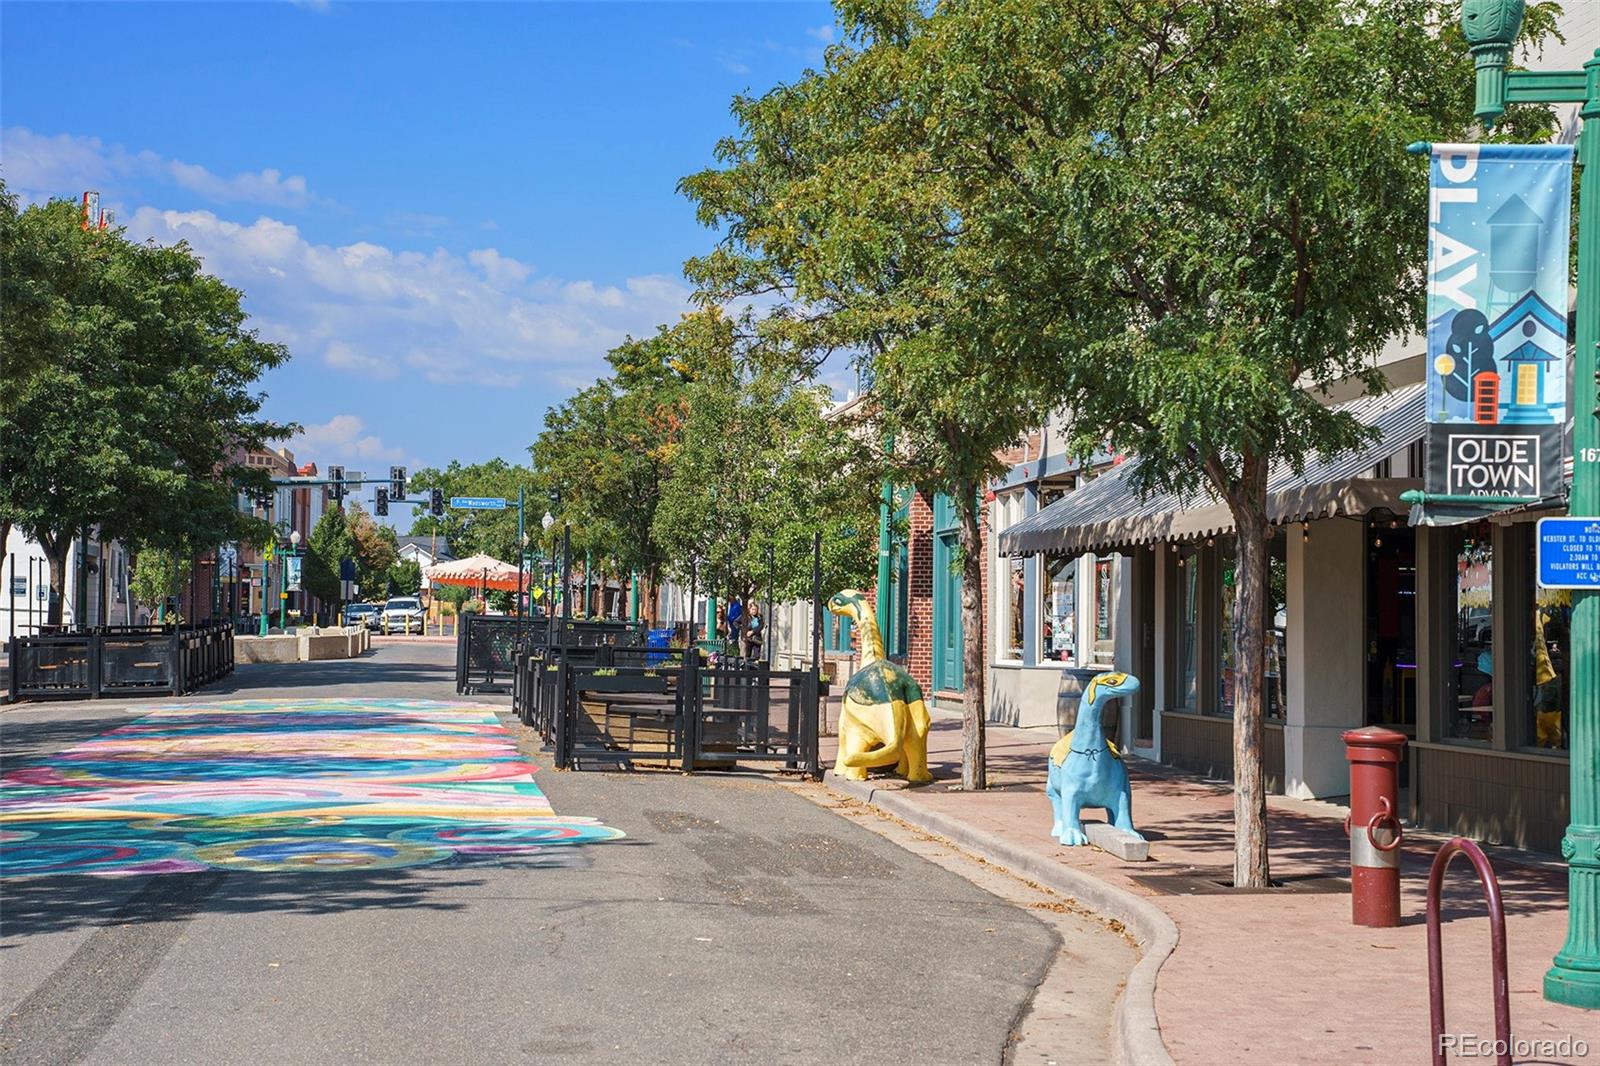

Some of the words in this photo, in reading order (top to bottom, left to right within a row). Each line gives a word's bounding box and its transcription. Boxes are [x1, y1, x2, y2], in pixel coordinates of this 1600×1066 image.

[1428, 143, 1479, 310] PLAY
[1457, 439, 1529, 463] OLDE
[1452, 464, 1536, 488] TOWN
[1543, 535, 1567, 543] WEBSTER
[1579, 535, 1587, 543] TO
[1562, 544, 1584, 552] CLOSED
[1586, 544, 1593, 552] TO
[1591, 553, 1598, 561] TO
[1576, 572, 1588, 580] ACC
